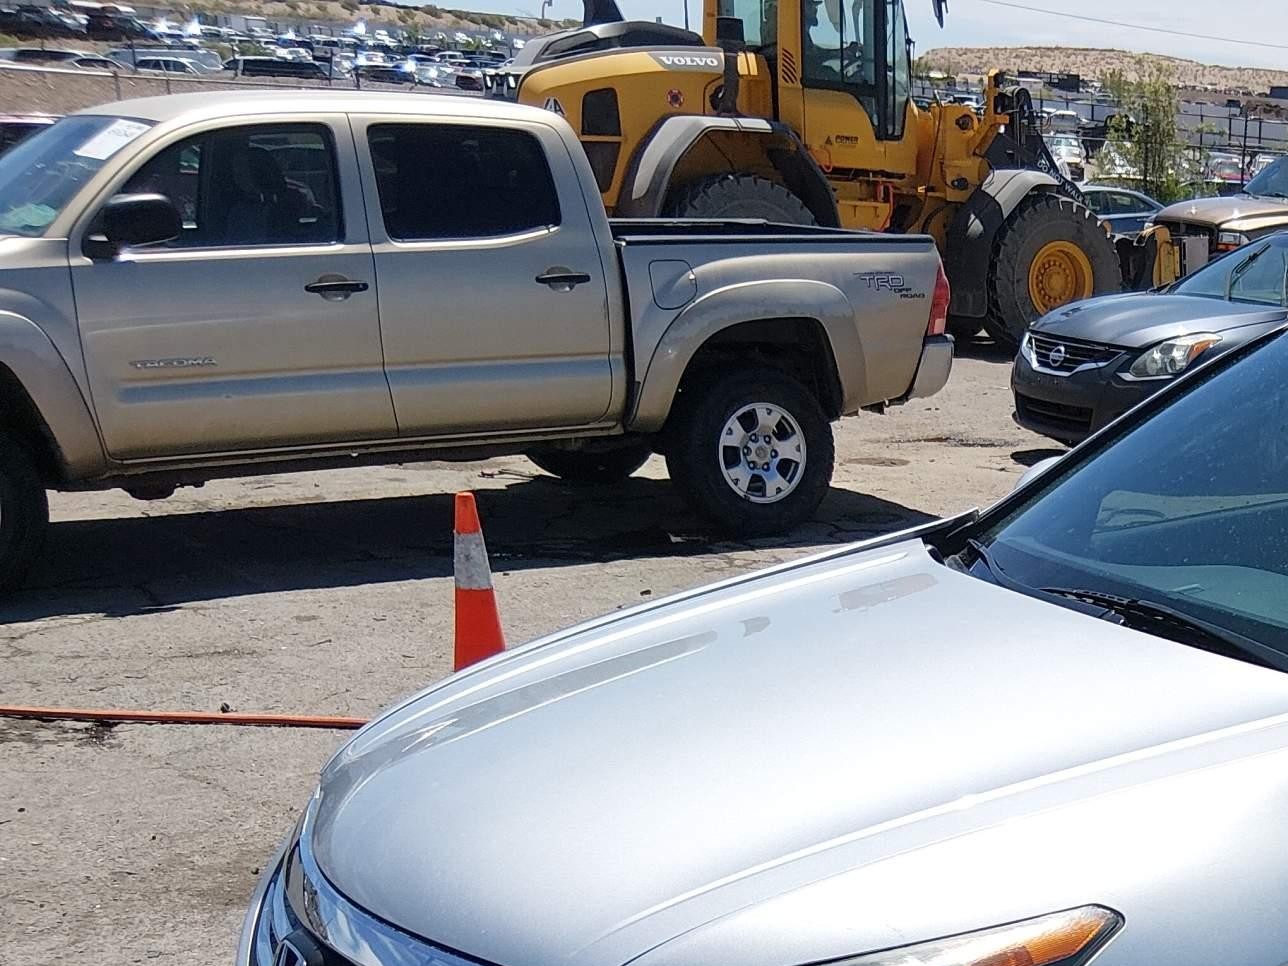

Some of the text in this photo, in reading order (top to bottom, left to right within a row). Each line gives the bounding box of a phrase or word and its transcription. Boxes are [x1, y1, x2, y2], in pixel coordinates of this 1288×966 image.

[659, 55, 719, 66] VOLVO
[1037, 160, 1048, 172] DO
[860, 275, 905, 291] TRD
[128, 356, 219, 370] TACOMA
